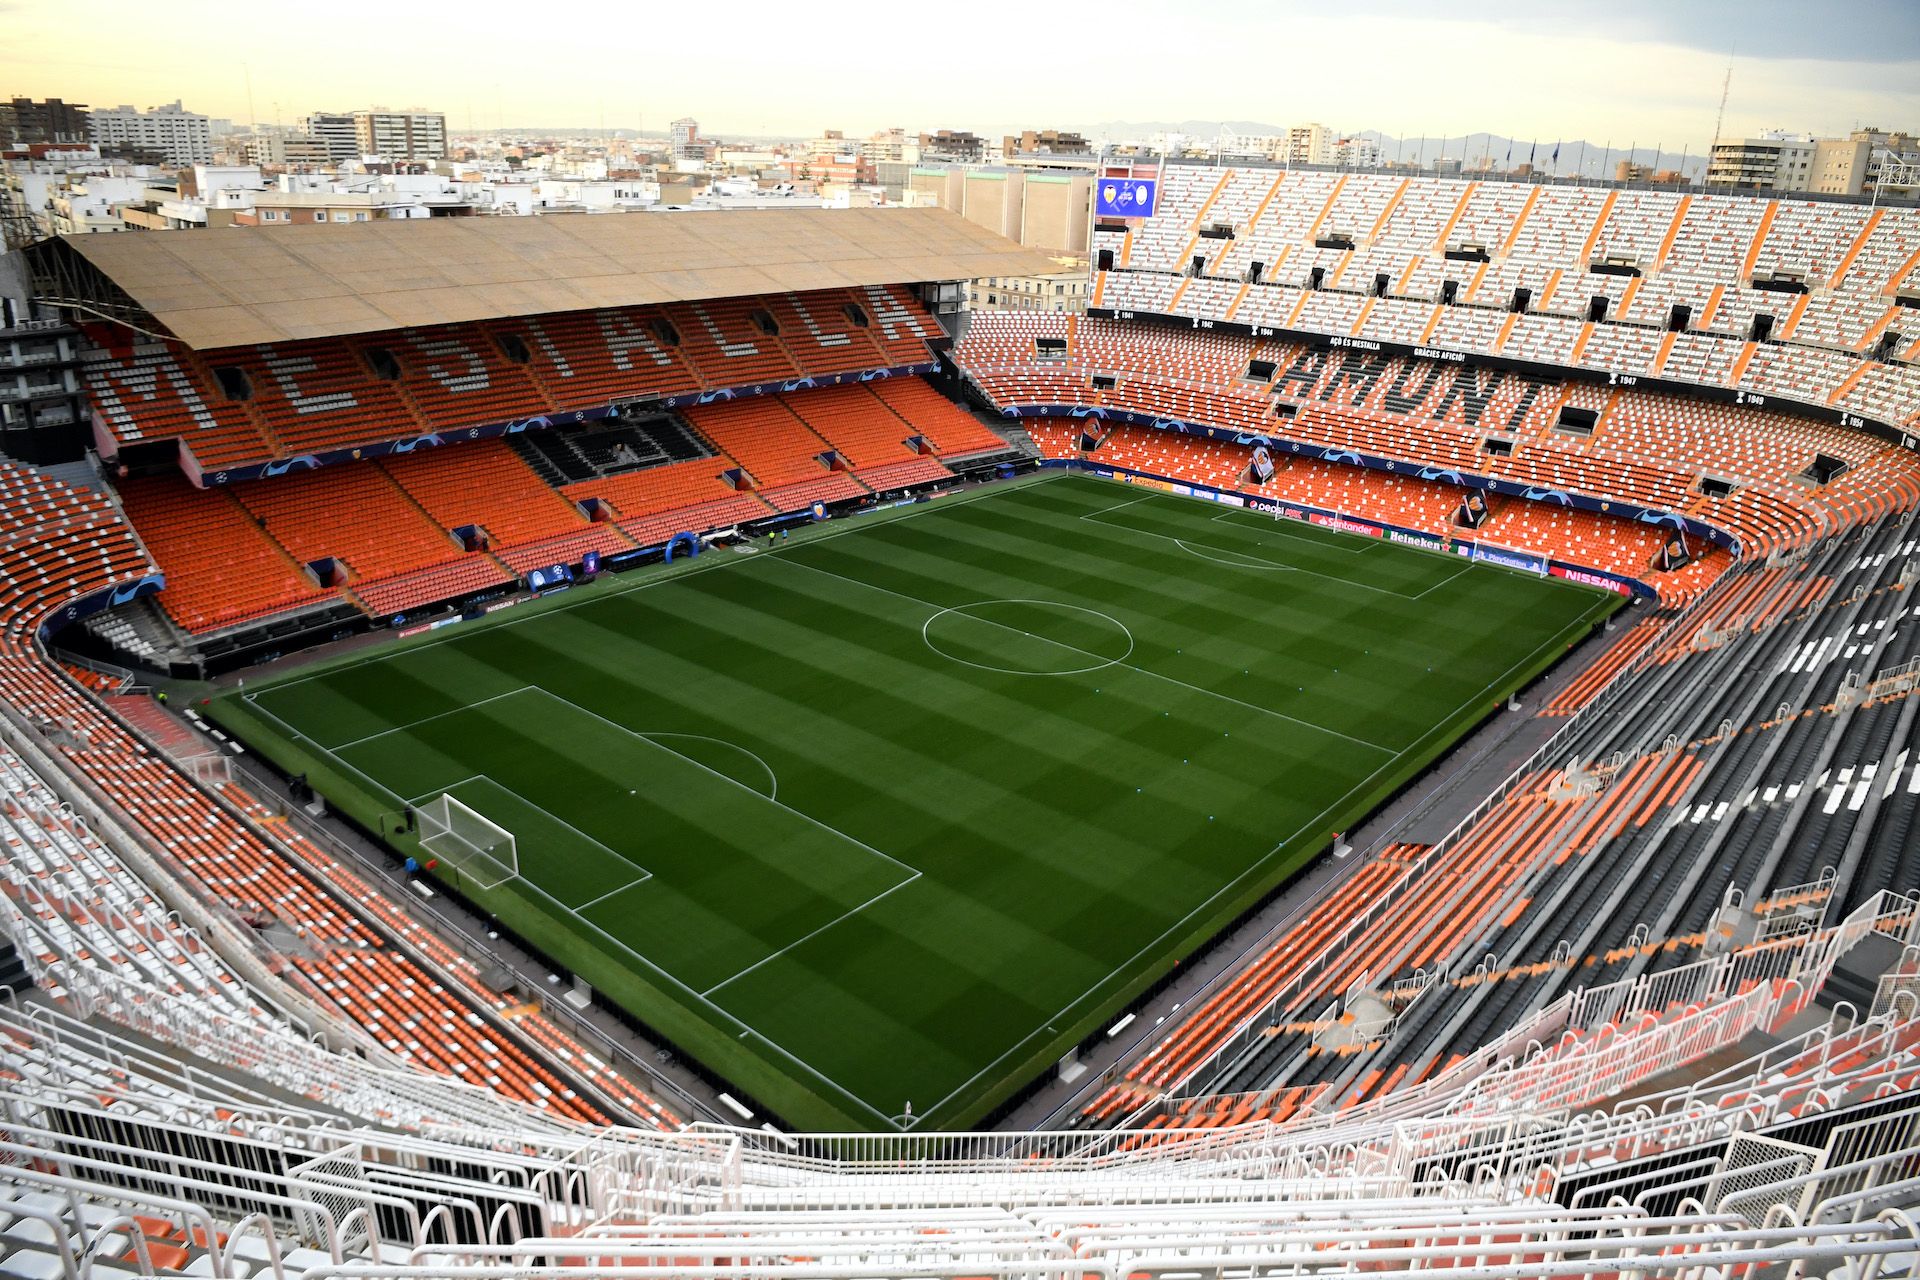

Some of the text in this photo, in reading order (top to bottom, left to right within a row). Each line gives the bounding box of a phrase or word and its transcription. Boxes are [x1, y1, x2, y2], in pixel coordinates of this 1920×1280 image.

[1352, 340, 1380, 350] MESTALLA
[1620, 376, 1636, 385] 1947
[1747, 395, 1764, 405] 1949
[1258, 502, 1284, 515] pepsi
[1328, 517, 1373, 535] Santander
[1390, 531, 1441, 551] Heineken
[1488, 553, 1527, 568] PlayStation
[1565, 570, 1621, 592] NISSAN
[486, 600, 515, 613] NISSAN
